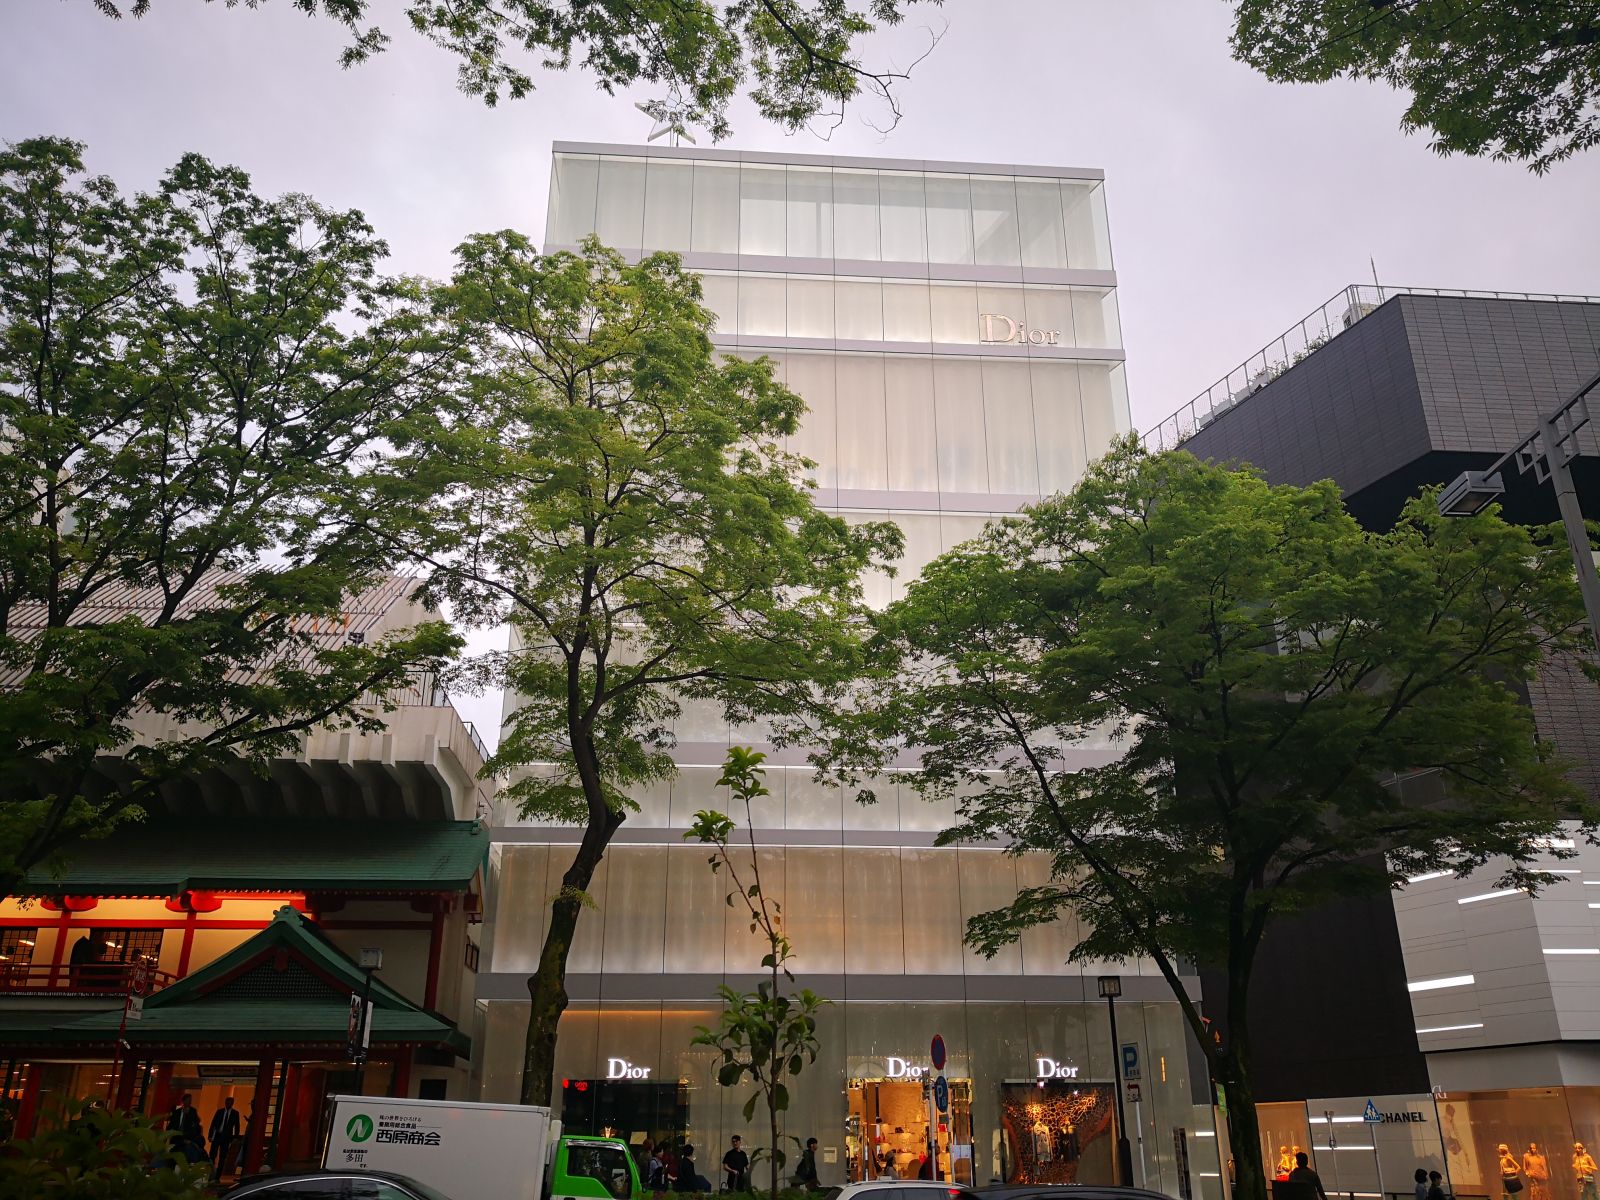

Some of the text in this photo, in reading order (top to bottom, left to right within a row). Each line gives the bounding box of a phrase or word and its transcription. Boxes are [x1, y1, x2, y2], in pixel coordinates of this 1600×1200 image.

[980, 313, 1061, 344] Dior
[606, 1058, 652, 1079] Dior
[1036, 1058, 1079, 1078] Dior
[1379, 1111, 1427, 1123] CHANEL
[376, 1129, 441, 1146] 西原商会
